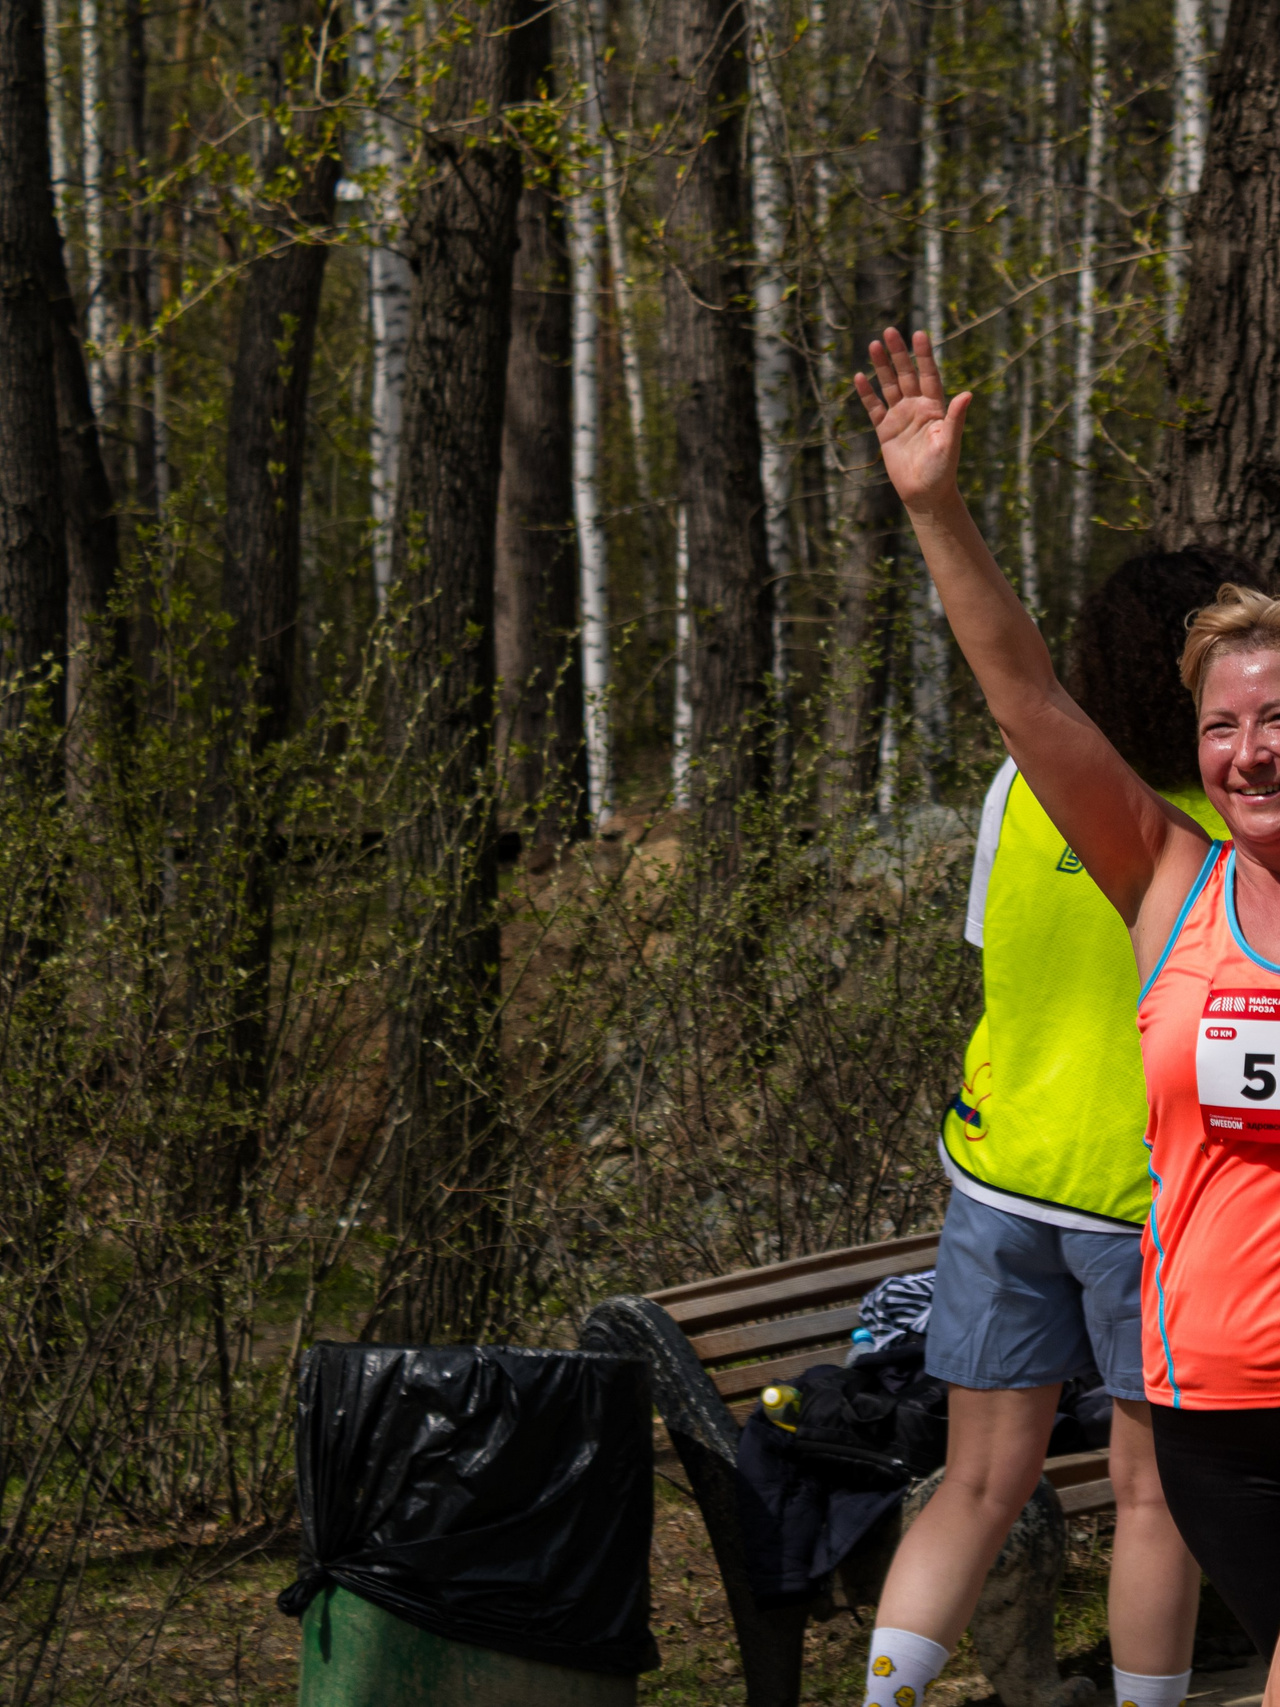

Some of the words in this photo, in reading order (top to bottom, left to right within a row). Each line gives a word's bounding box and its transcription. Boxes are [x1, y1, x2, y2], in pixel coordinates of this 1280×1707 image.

[1248, 1005, 1276, 1013] ГРОЗА
[1209, 1030, 1219, 1038] 10
[1209, 1118, 1243, 1130] SWEEDOM
